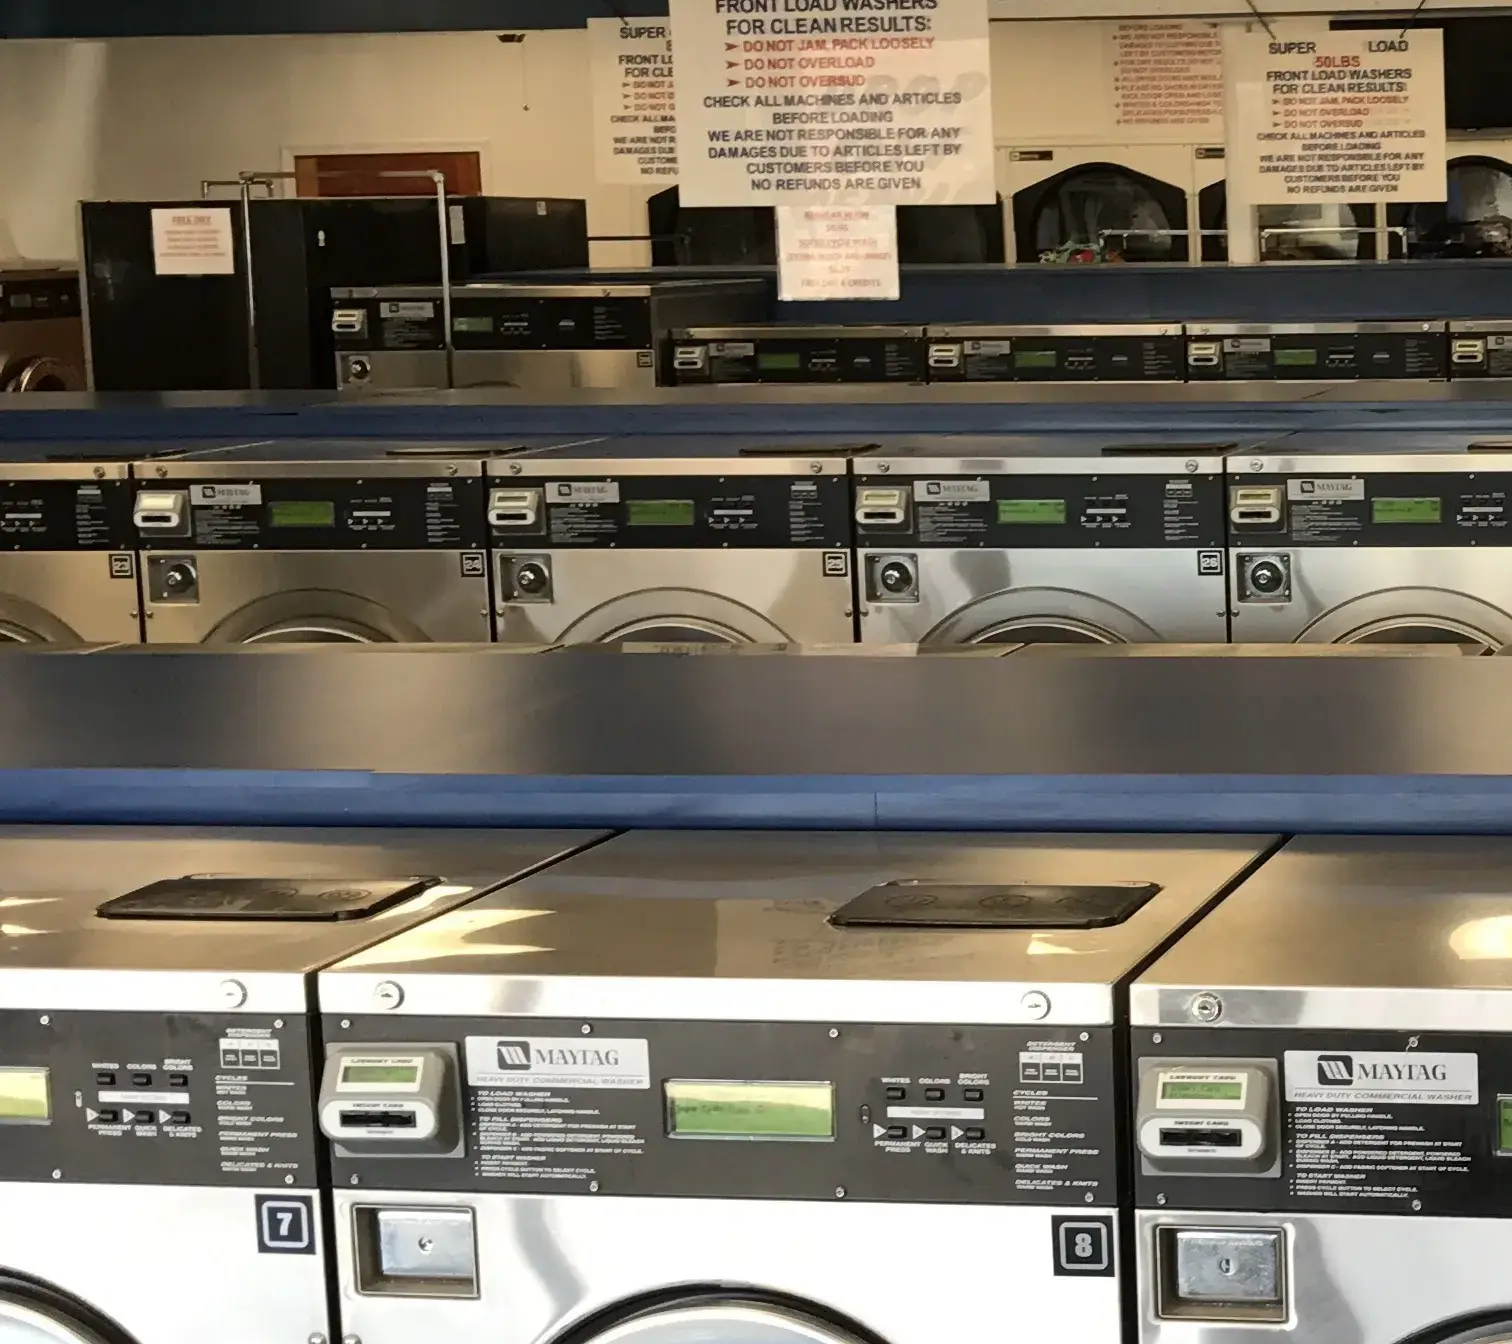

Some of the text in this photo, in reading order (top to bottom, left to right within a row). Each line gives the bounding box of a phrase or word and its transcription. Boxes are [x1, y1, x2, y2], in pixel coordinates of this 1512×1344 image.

[726, 16, 931, 35] FOR CLEAN RESULTS:
[620, 27, 665, 39] SUPER
[743, 41, 763, 52] DO
[767, 40, 794, 51] NOT
[833, 38, 868, 50] PACK
[872, 36, 935, 50] LOOSELY
[1269, 41, 1409, 54] SUPER LOAD
[618, 55, 659, 65] FRONT
[744, 57, 875, 70] DO NOT OVERLOAD
[625, 68, 649, 77] FOR
[1267, 69, 1412, 81] FRONT LOAD WASHERS
[745, 75, 866, 88] DO NOT OVERSUD
[1273, 84, 1298, 94] FOR
[1302, 83, 1345, 93] CLEAN
[703, 92, 961, 107] CHECK ALL MACHINES AND ARTICLES
[1367, 96, 1408, 104] LOOSELY
[773, 111, 893, 124] BEFORE LOADING
[1319, 108, 1369, 116] OVERLOAD
[708, 127, 961, 142] WE ARE NOT RESPONSIBLE FOR ANY
[1257, 132, 1287, 140] CHECK
[1290, 132, 1309, 140] ALL
[1310, 131, 1357, 139] MACHINES
[1380, 130, 1425, 138] ARTICLES
[708, 144, 961, 159] DAMAGES DUE TO ARTICLES LEFT BY
[1302, 143, 1338, 151] BEFORE
[747, 161, 924, 174] CUSTOMERS BEFORE YOU
[751, 177, 921, 190] NO REFUNDS ARE GIVEN
[827, 558, 844, 569] 25
[534, 1049, 619, 1066] MAYTAG
[1357, 1063, 1447, 1081] MAYTAG
[276, 1211, 293, 1236] 7
[1074, 1232, 1093, 1258] 8
